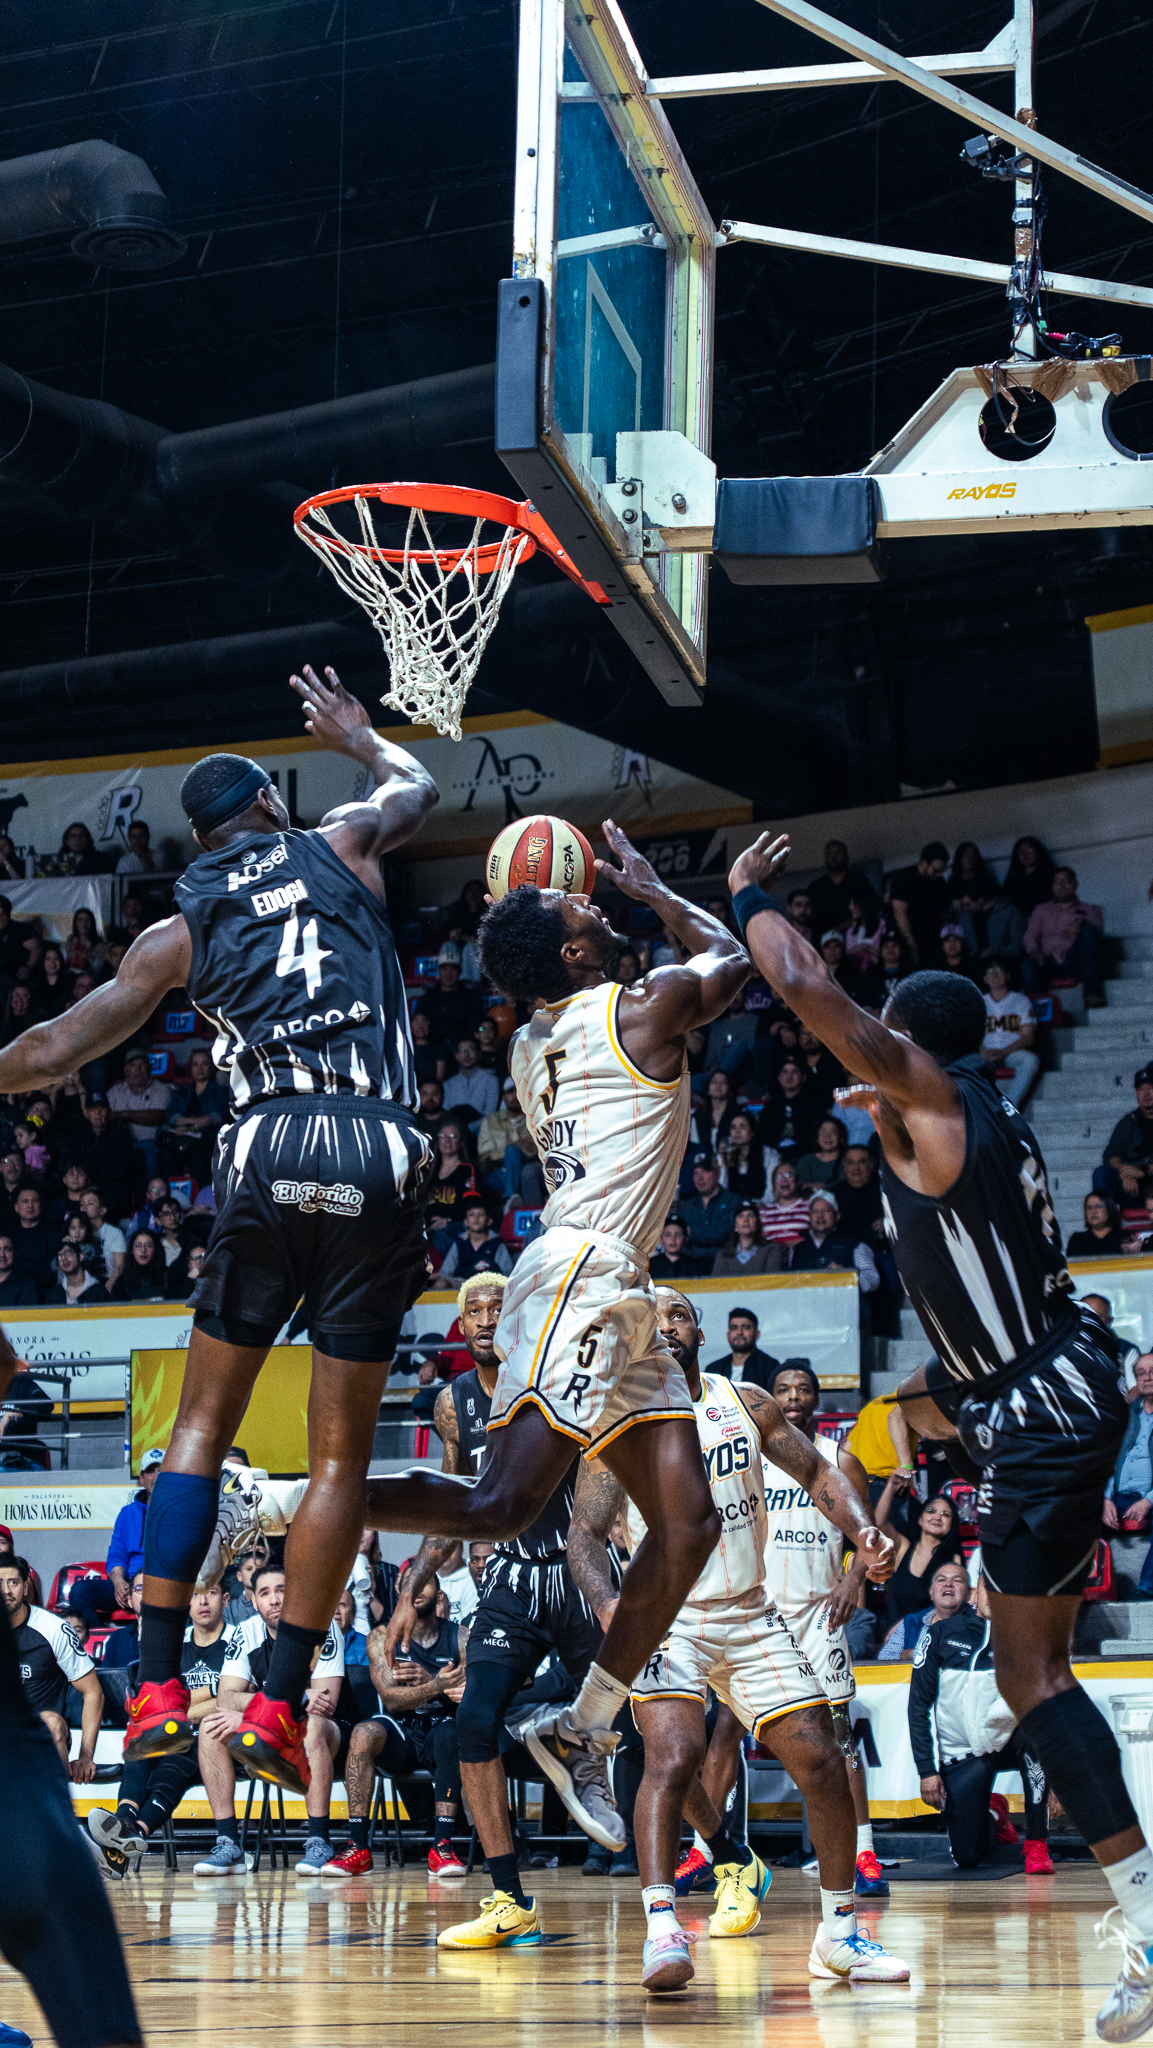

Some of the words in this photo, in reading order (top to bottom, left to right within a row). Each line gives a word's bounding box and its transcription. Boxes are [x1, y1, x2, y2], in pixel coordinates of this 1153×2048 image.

[947, 482, 1017, 501] RAYOS
[489, 855, 498, 879] FIBA
[251, 878, 309, 917] EDOGI
[276, 903, 333, 1000] 4
[539, 1049, 567, 1116] 5
[275, 1184, 297, 1201] El
[577, 1324, 603, 1369] 5
[560, 1372, 591, 1418] R
[4, 1504, 38, 1521] HOJAS
[774, 1530, 816, 1544] ARCO
[482, 1638, 510, 1648] MEGA
